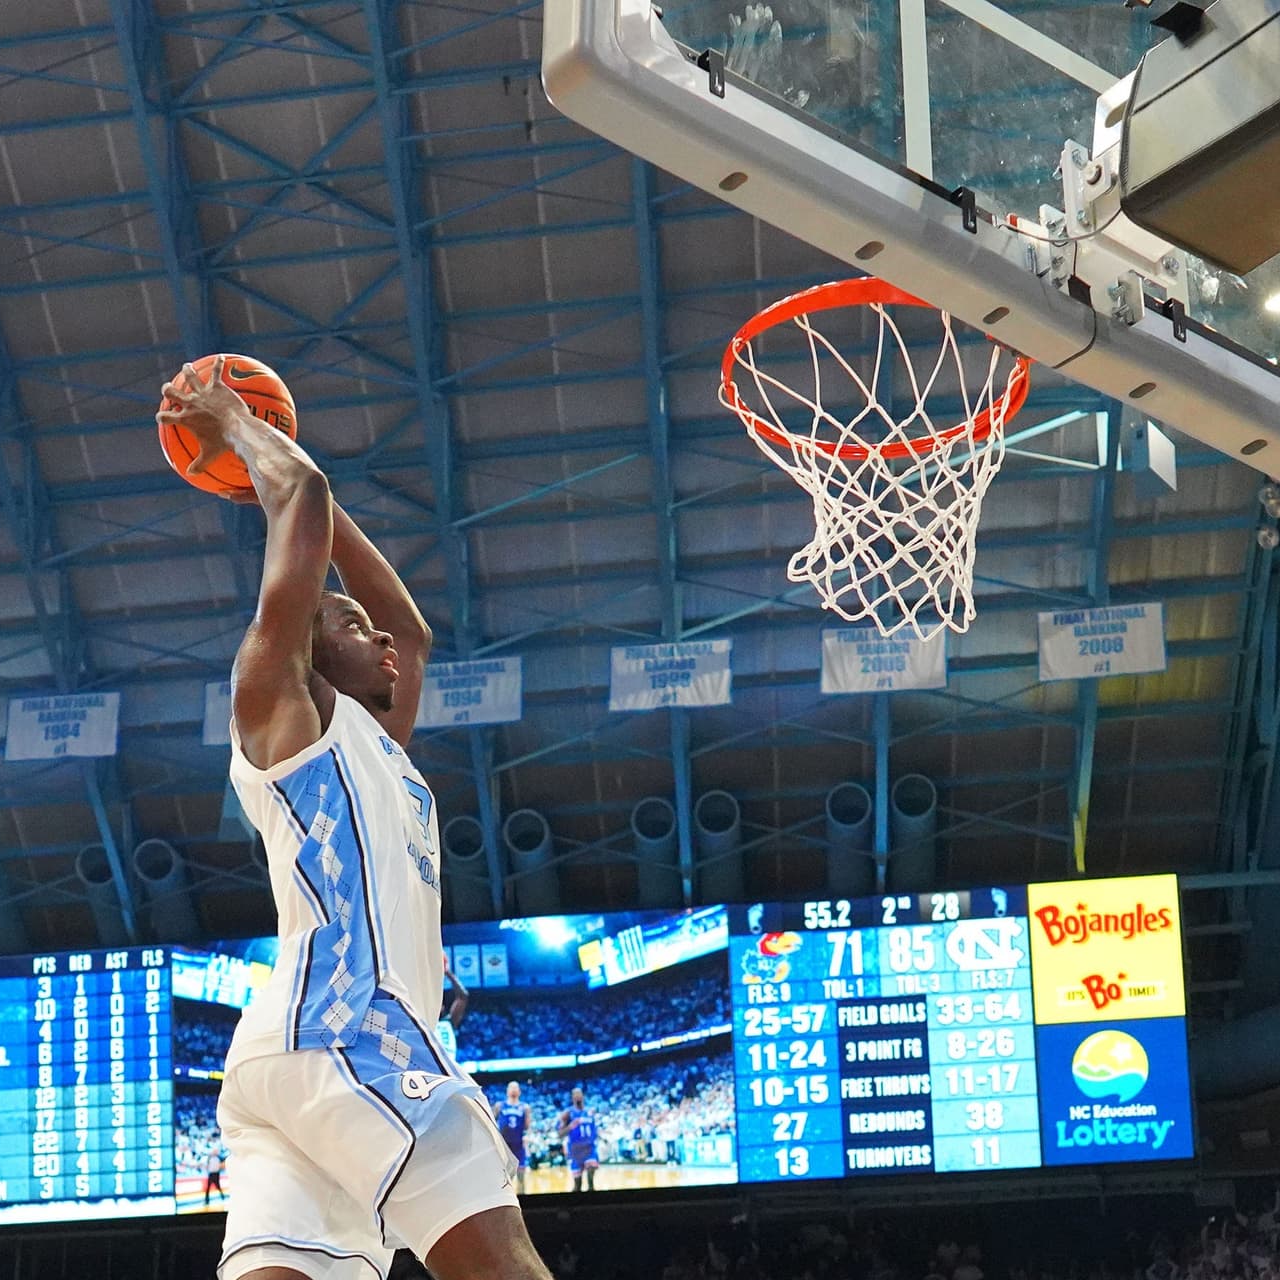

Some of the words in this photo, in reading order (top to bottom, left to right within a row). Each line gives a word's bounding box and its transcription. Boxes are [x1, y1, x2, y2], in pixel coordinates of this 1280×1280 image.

[804, 900, 851, 929] 55.2
[931, 892, 960, 921] 28
[1034, 903, 1171, 947] Bojangles
[33, 957, 56, 974] PTS
[69, 954, 92, 972] REB
[105, 951, 128, 969] AST
[142, 949, 164, 967] FLS
[827, 930, 863, 977] 71
[888, 926, 935, 974] 85
[744, 1004, 827, 1037] 25-57
[838, 1005, 878, 1027] FIELD
[880, 1002, 926, 1024] GOALS
[935, 991, 1022, 1025] 33-64
[748, 1039, 827, 1072] 11-24
[846, 1042, 857, 1062] 3
[858, 1039, 901, 1061] POINT
[903, 1037, 923, 1058] FG
[947, 1029, 1015, 1060] 8-26
[749, 1074, 829, 1107] 10-15
[841, 1077, 873, 1099] FREE
[874, 1074, 932, 1097] THROWS
[945, 1064, 1020, 1096] 11-17
[772, 1111, 809, 1142] 27
[849, 1110, 926, 1134] REBOUNDS
[965, 1100, 1005, 1130] 38
[1070, 1106, 1090, 1119] NC
[1093, 1103, 1156, 1117] Education
[1056, 1119, 1172, 1149] Lottery
[774, 1146, 809, 1177] 13
[847, 1145, 932, 1170] TURNOVERS
[971, 1135, 1002, 1166] 11
